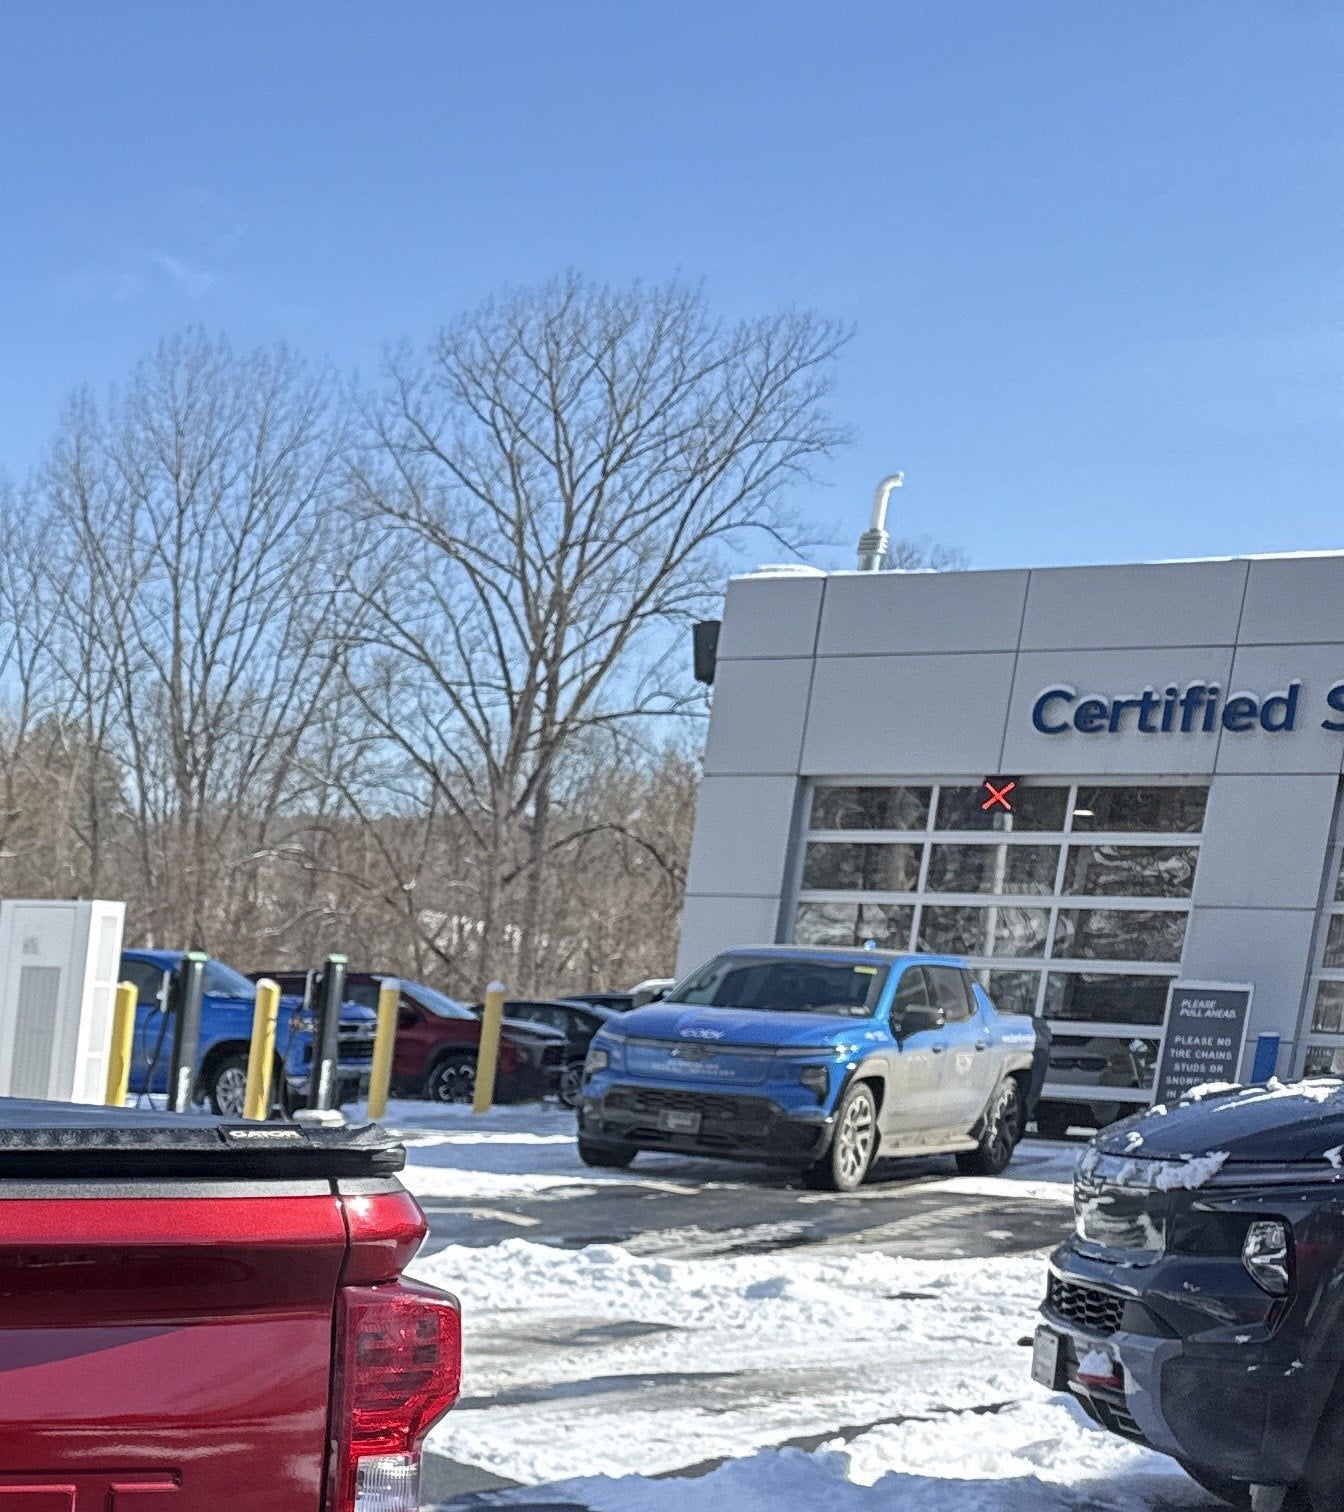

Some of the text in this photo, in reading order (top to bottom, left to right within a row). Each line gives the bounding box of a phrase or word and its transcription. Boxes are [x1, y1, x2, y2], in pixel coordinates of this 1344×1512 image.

[1031, 683, 1302, 735] Certified
[1181, 999, 1217, 1009] PLEASE
[1174, 1035, 1232, 1047] PLEASE NO
[1170, 1048, 1233, 1061] TIRE CHAINS
[1174, 1062, 1224, 1074] STUDS OR
